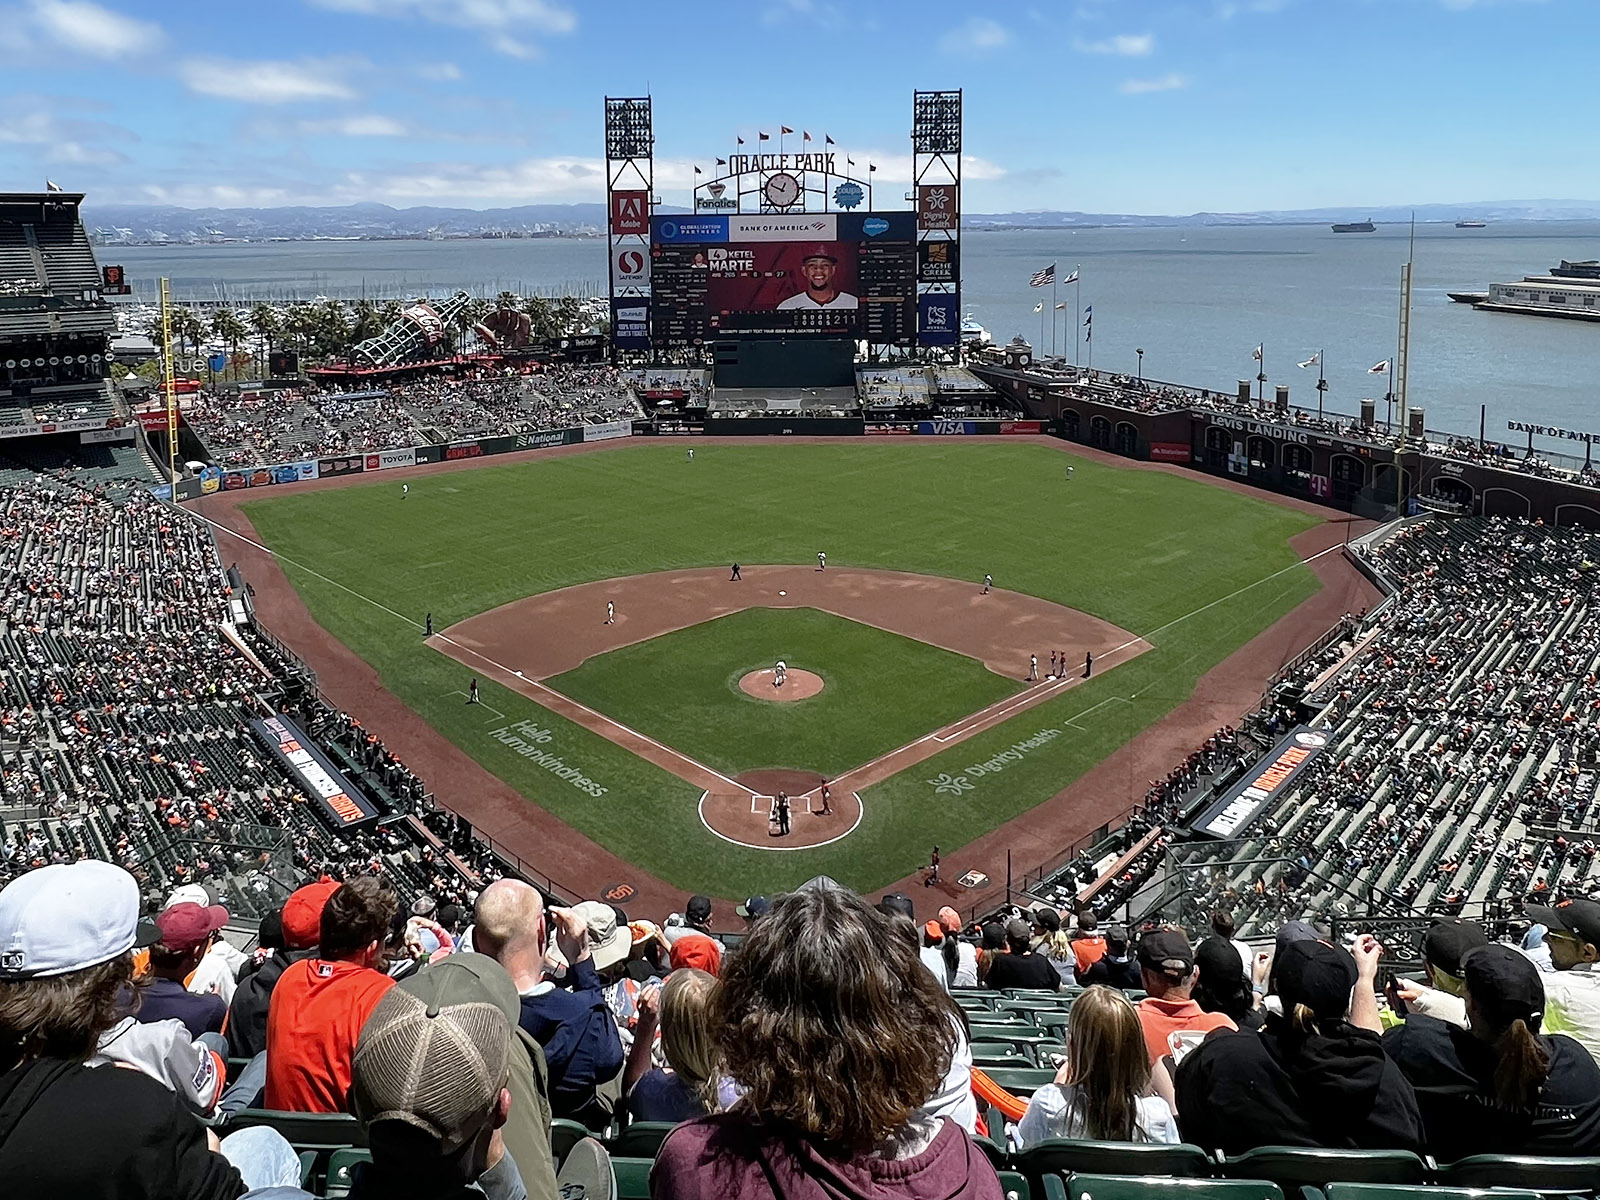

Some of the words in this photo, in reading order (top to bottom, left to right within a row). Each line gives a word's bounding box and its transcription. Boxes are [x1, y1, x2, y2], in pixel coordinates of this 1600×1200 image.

[729, 154, 788, 176] ORACLE
[794, 153, 835, 174] PARK
[696, 200, 737, 209] Fanatics
[620, 220, 641, 228] Adobe
[923, 211, 951, 221] Dignity
[728, 250, 756, 258] KETEL
[709, 260, 754, 271] MARTE
[833, 315, 841, 324] 2
[141, 417, 169, 426] ORACL
[930, 423, 965, 434] VISA
[1507, 421, 1545, 435] BANK
[1547, 427, 1566, 438] OF
[528, 432, 564, 444] National
[1247, 422, 1308, 445] LANDING
[382, 454, 413, 463] TOYOTA
[1311, 474, 1328, 497] T
[510, 719, 553, 744] Hello
[1015, 728, 1063, 753] Health
[487, 726, 609, 798] humankindness
[964, 744, 1024, 777] Dignity
[1251, 762, 1298, 792] ORACLE
[1276, 745, 1311, 765] PARK
[326, 793, 366, 823] GIANTS
[1205, 795, 1265, 836] WELCOME
